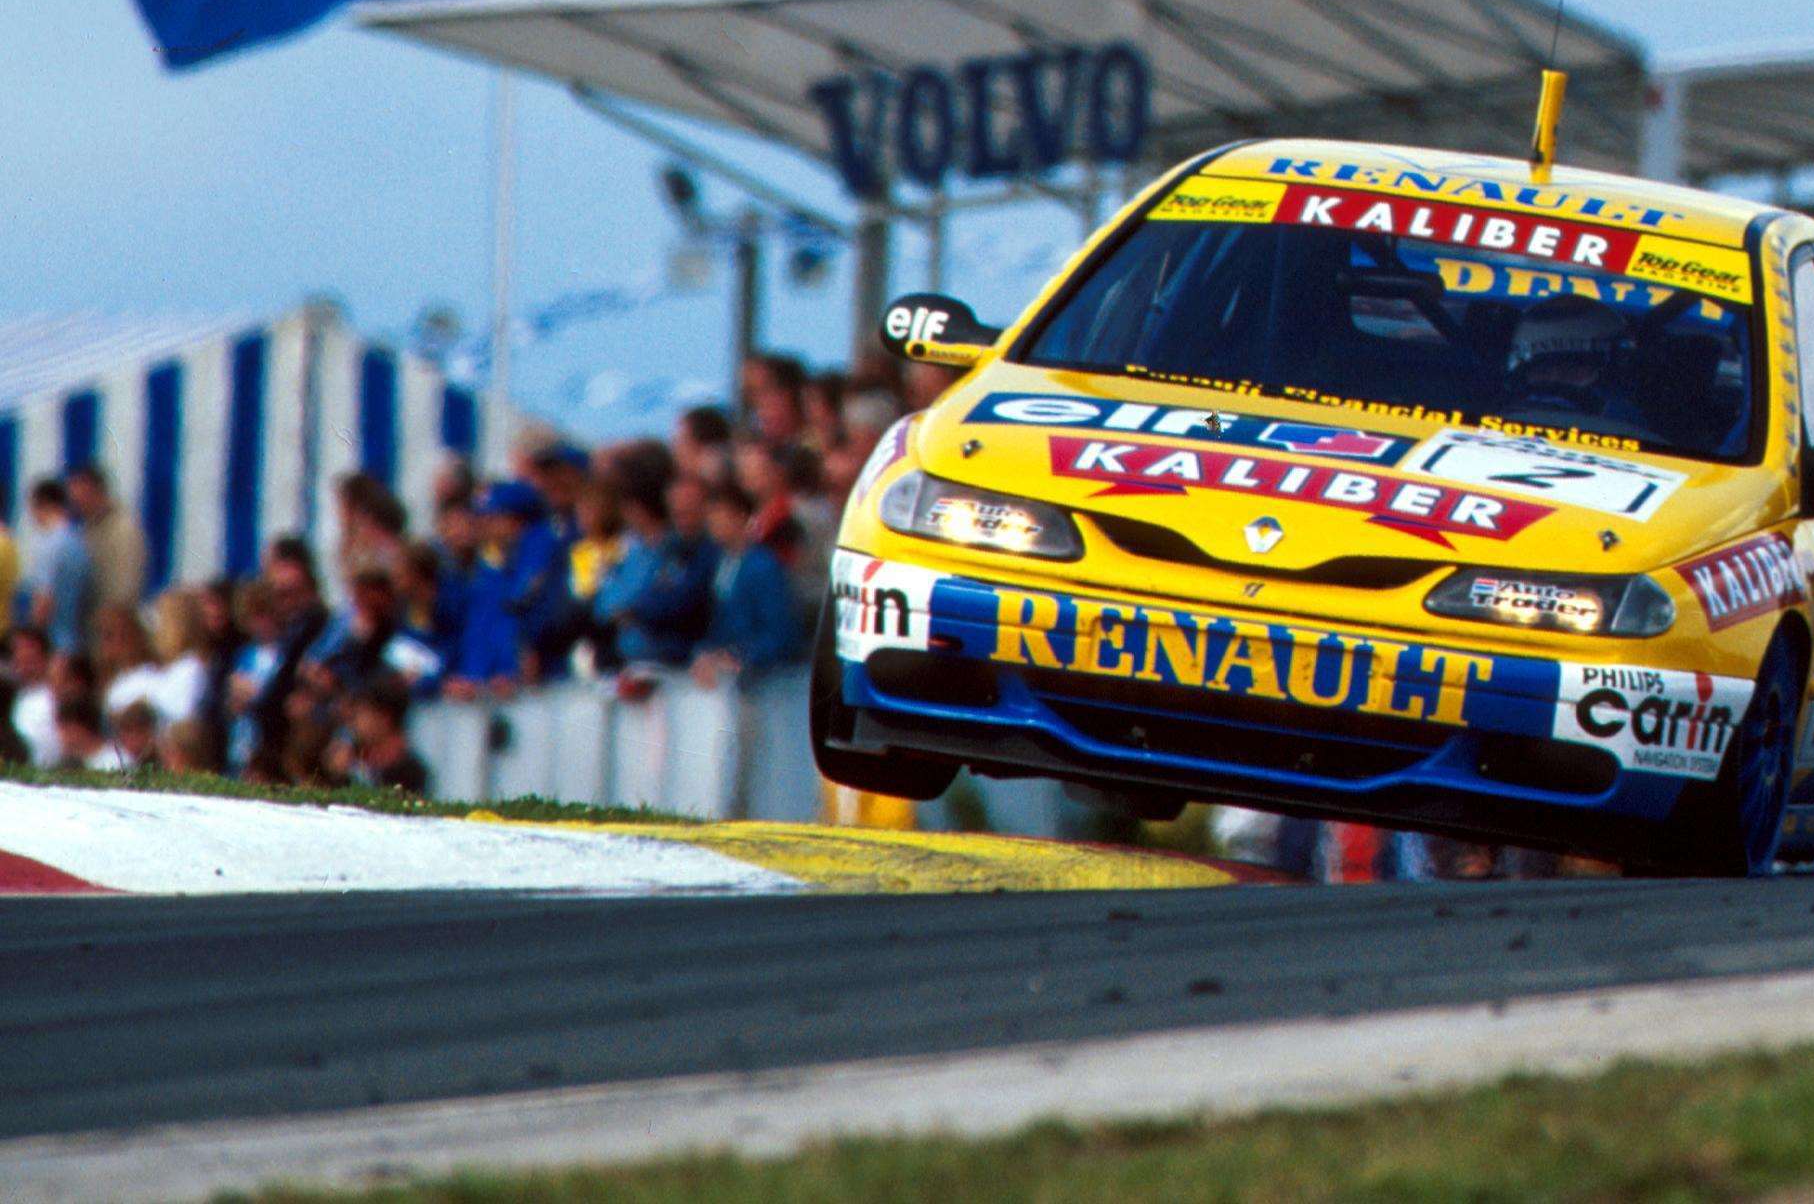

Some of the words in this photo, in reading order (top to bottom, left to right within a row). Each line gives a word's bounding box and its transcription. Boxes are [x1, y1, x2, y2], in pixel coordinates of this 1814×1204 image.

[808, 40, 1153, 196] VOLVO
[1267, 156, 1687, 227] RENAULT
[1299, 194, 1609, 268] KALIBER
[1631, 264, 1743, 294] MAGAZINE
[1637, 250, 1679, 271] Top
[1680, 260, 1744, 285] Gear
[885, 306, 950, 341] elf
[992, 397, 1241, 437] elf
[1480, 414, 1641, 453] Services
[1073, 441, 1508, 531] KALIBER
[1486, 465, 1597, 489] 2
[1472, 592, 1597, 617] Trader
[1499, 580, 1575, 601] Auto
[989, 587, 1493, 727] RENAULT
[1582, 666, 1665, 695] PHILIPS
[1575, 671, 1733, 754] carin
